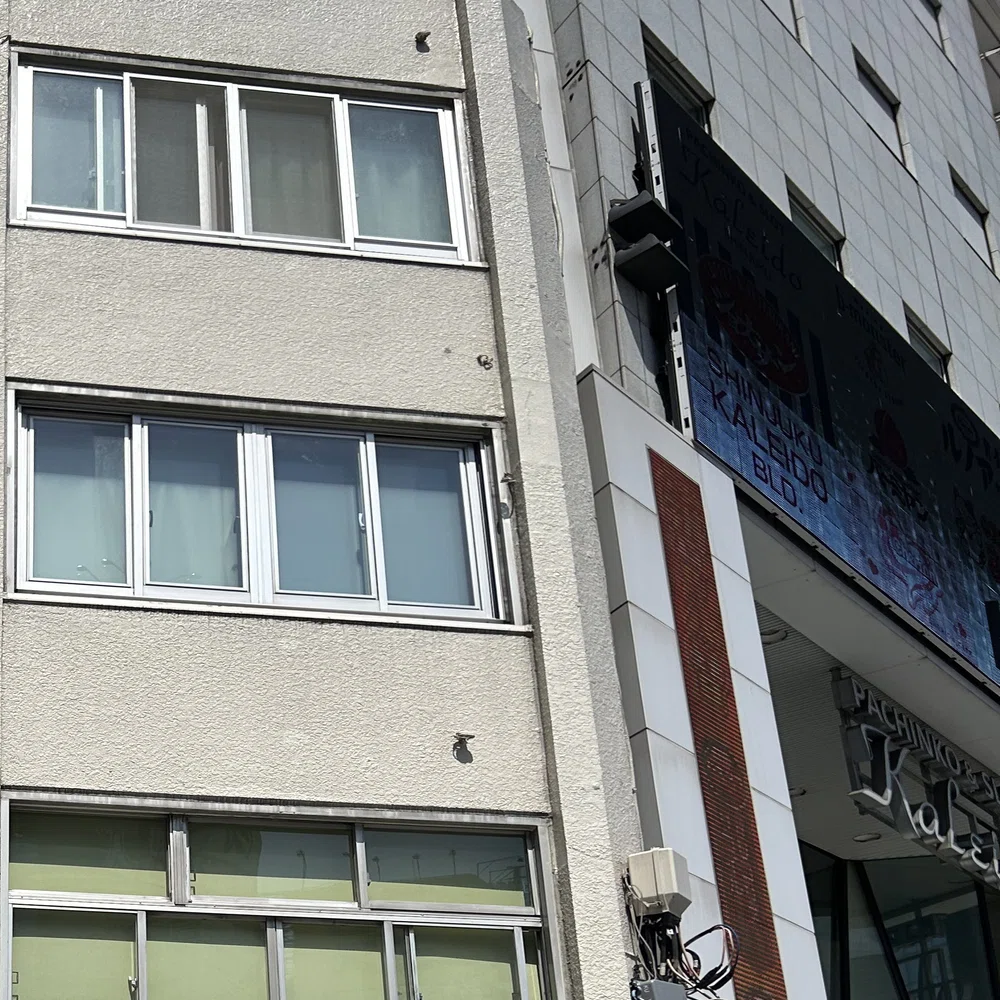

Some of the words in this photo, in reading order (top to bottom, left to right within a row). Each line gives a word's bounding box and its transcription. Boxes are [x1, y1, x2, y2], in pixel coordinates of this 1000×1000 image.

[707, 346, 823, 466] SHINJUKU
[710, 379, 828, 503] KALEIDO
[851, 676, 961, 775] PACHINKO
